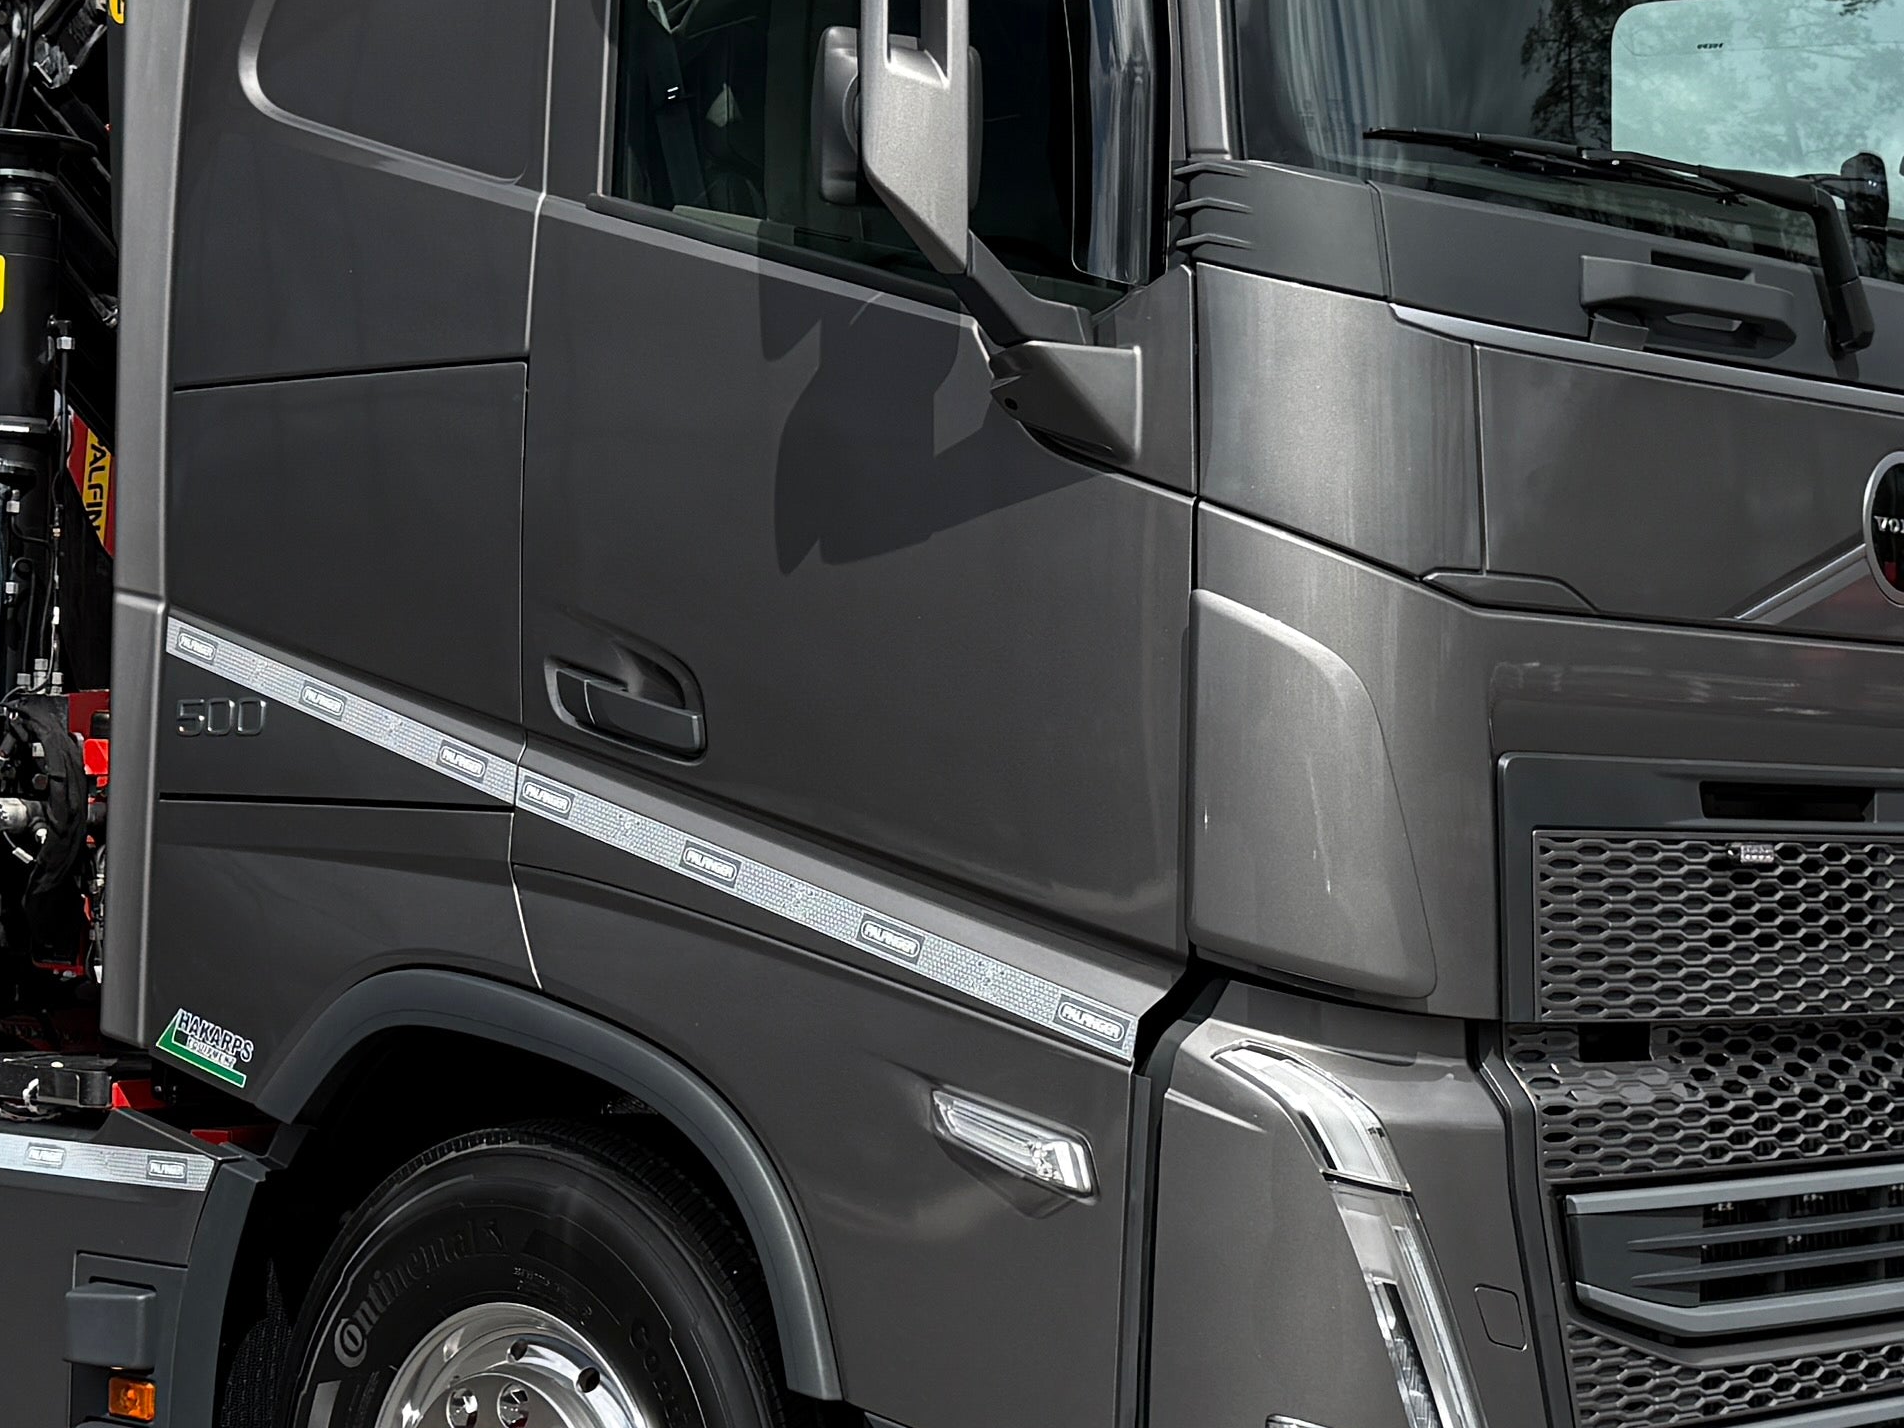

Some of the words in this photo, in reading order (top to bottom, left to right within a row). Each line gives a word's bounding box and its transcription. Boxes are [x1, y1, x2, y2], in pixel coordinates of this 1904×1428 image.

[176, 697, 266, 737] 500
[526, 783, 568, 810] PALFINGER
[686, 849, 733, 877] PALFINGER
[863, 924, 916, 954] PALFINGER
[177, 1011, 254, 1063] HAKARPS
[1062, 1005, 1120, 1039] PALFINGER
[332, 1226, 478, 1369] Continental
